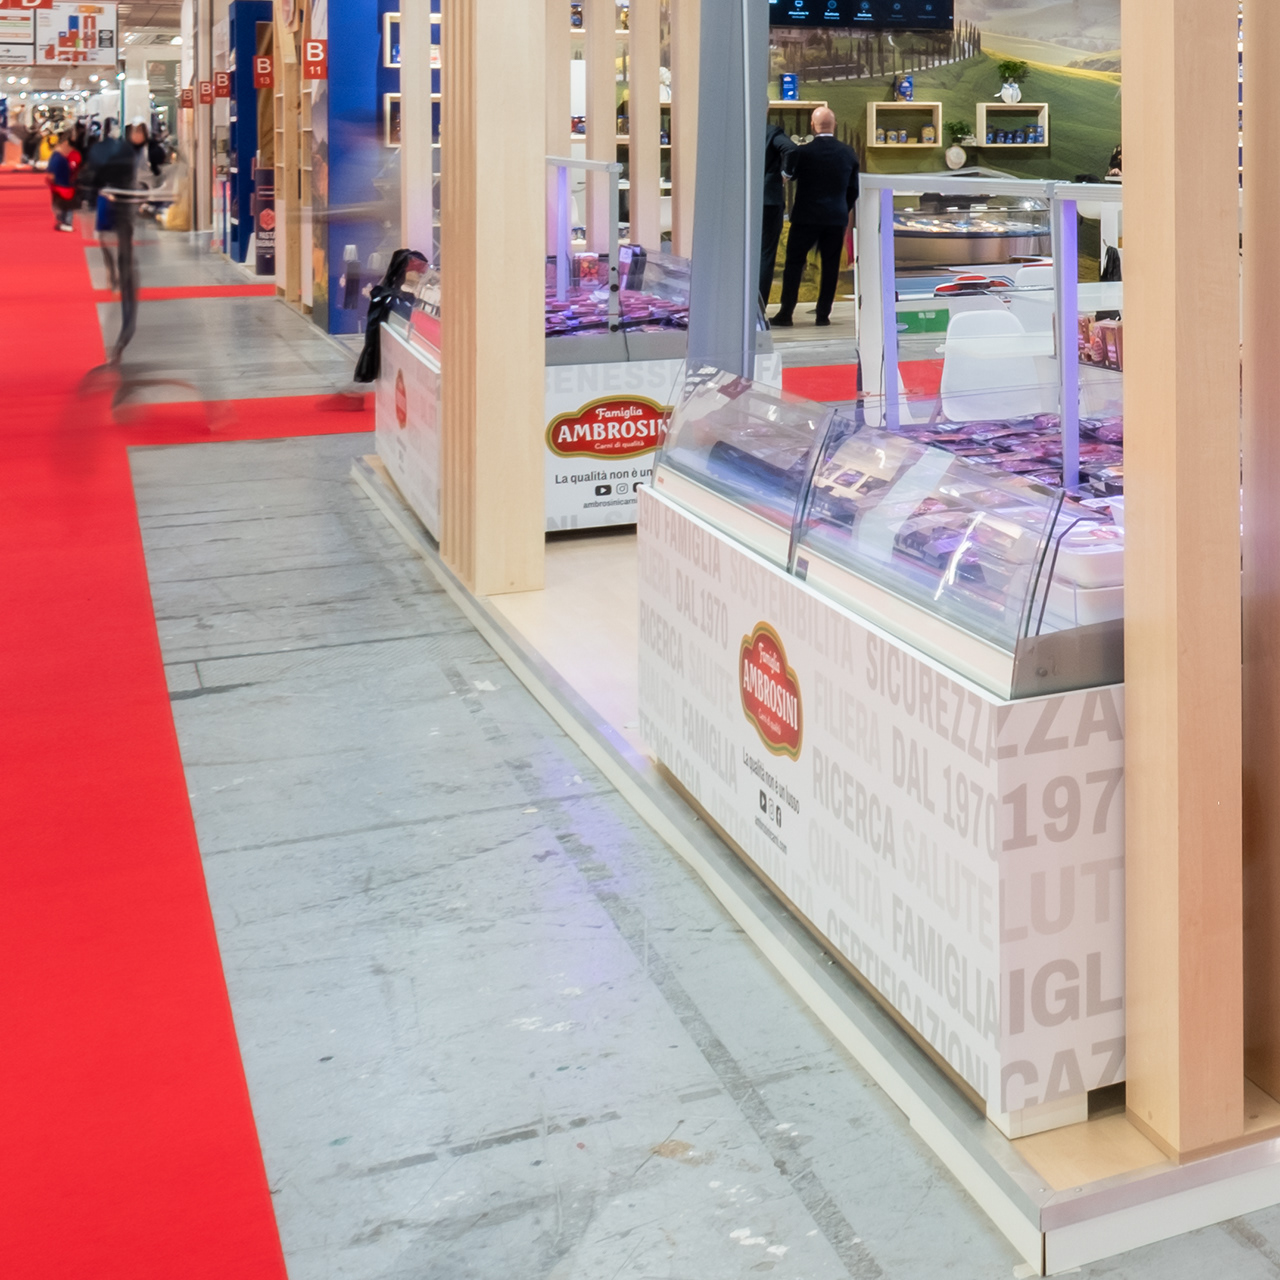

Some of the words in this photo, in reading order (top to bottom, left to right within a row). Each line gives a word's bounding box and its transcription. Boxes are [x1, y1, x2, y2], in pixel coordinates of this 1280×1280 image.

[307, 42, 324, 61] B
[257, 58, 271, 73] B
[309, 66, 321, 75] 11
[201, 83, 212, 94] B
[217, 74, 229, 86] B
[259, 77, 270, 85] 13
[183, 91, 193, 100] B
[595, 407, 643, 420] Famiglia
[558, 418, 673, 443] AMBROSIN
[594, 442, 612, 450] Carni
[555, 474, 568, 484] La
[570, 470, 607, 484] qualità
[609, 471, 629, 480] non
[631, 468, 638, 479] è
[663, 504, 721, 584] FAMIGLIA
[758, 641, 780, 674] Famiglia
[675, 566, 698, 628] DAL
[699, 584, 728, 653] 1970
[813, 667, 883, 776] FILIERA
[891, 723, 936, 818] DAL
[743, 659, 798, 731] AMBROSINI
[639, 597, 684, 680] RICERCA
[688, 638, 734, 724] SALUTE
[812, 742, 898, 874] RICERCA
[743, 746, 749, 765] La
[749, 755, 765, 786] qualità
[765, 770, 775, 789] non
[786, 784, 800, 814] lusso
[681, 694, 738, 796] FAMIGLIA
[807, 796, 886, 954] QUALITÀ
